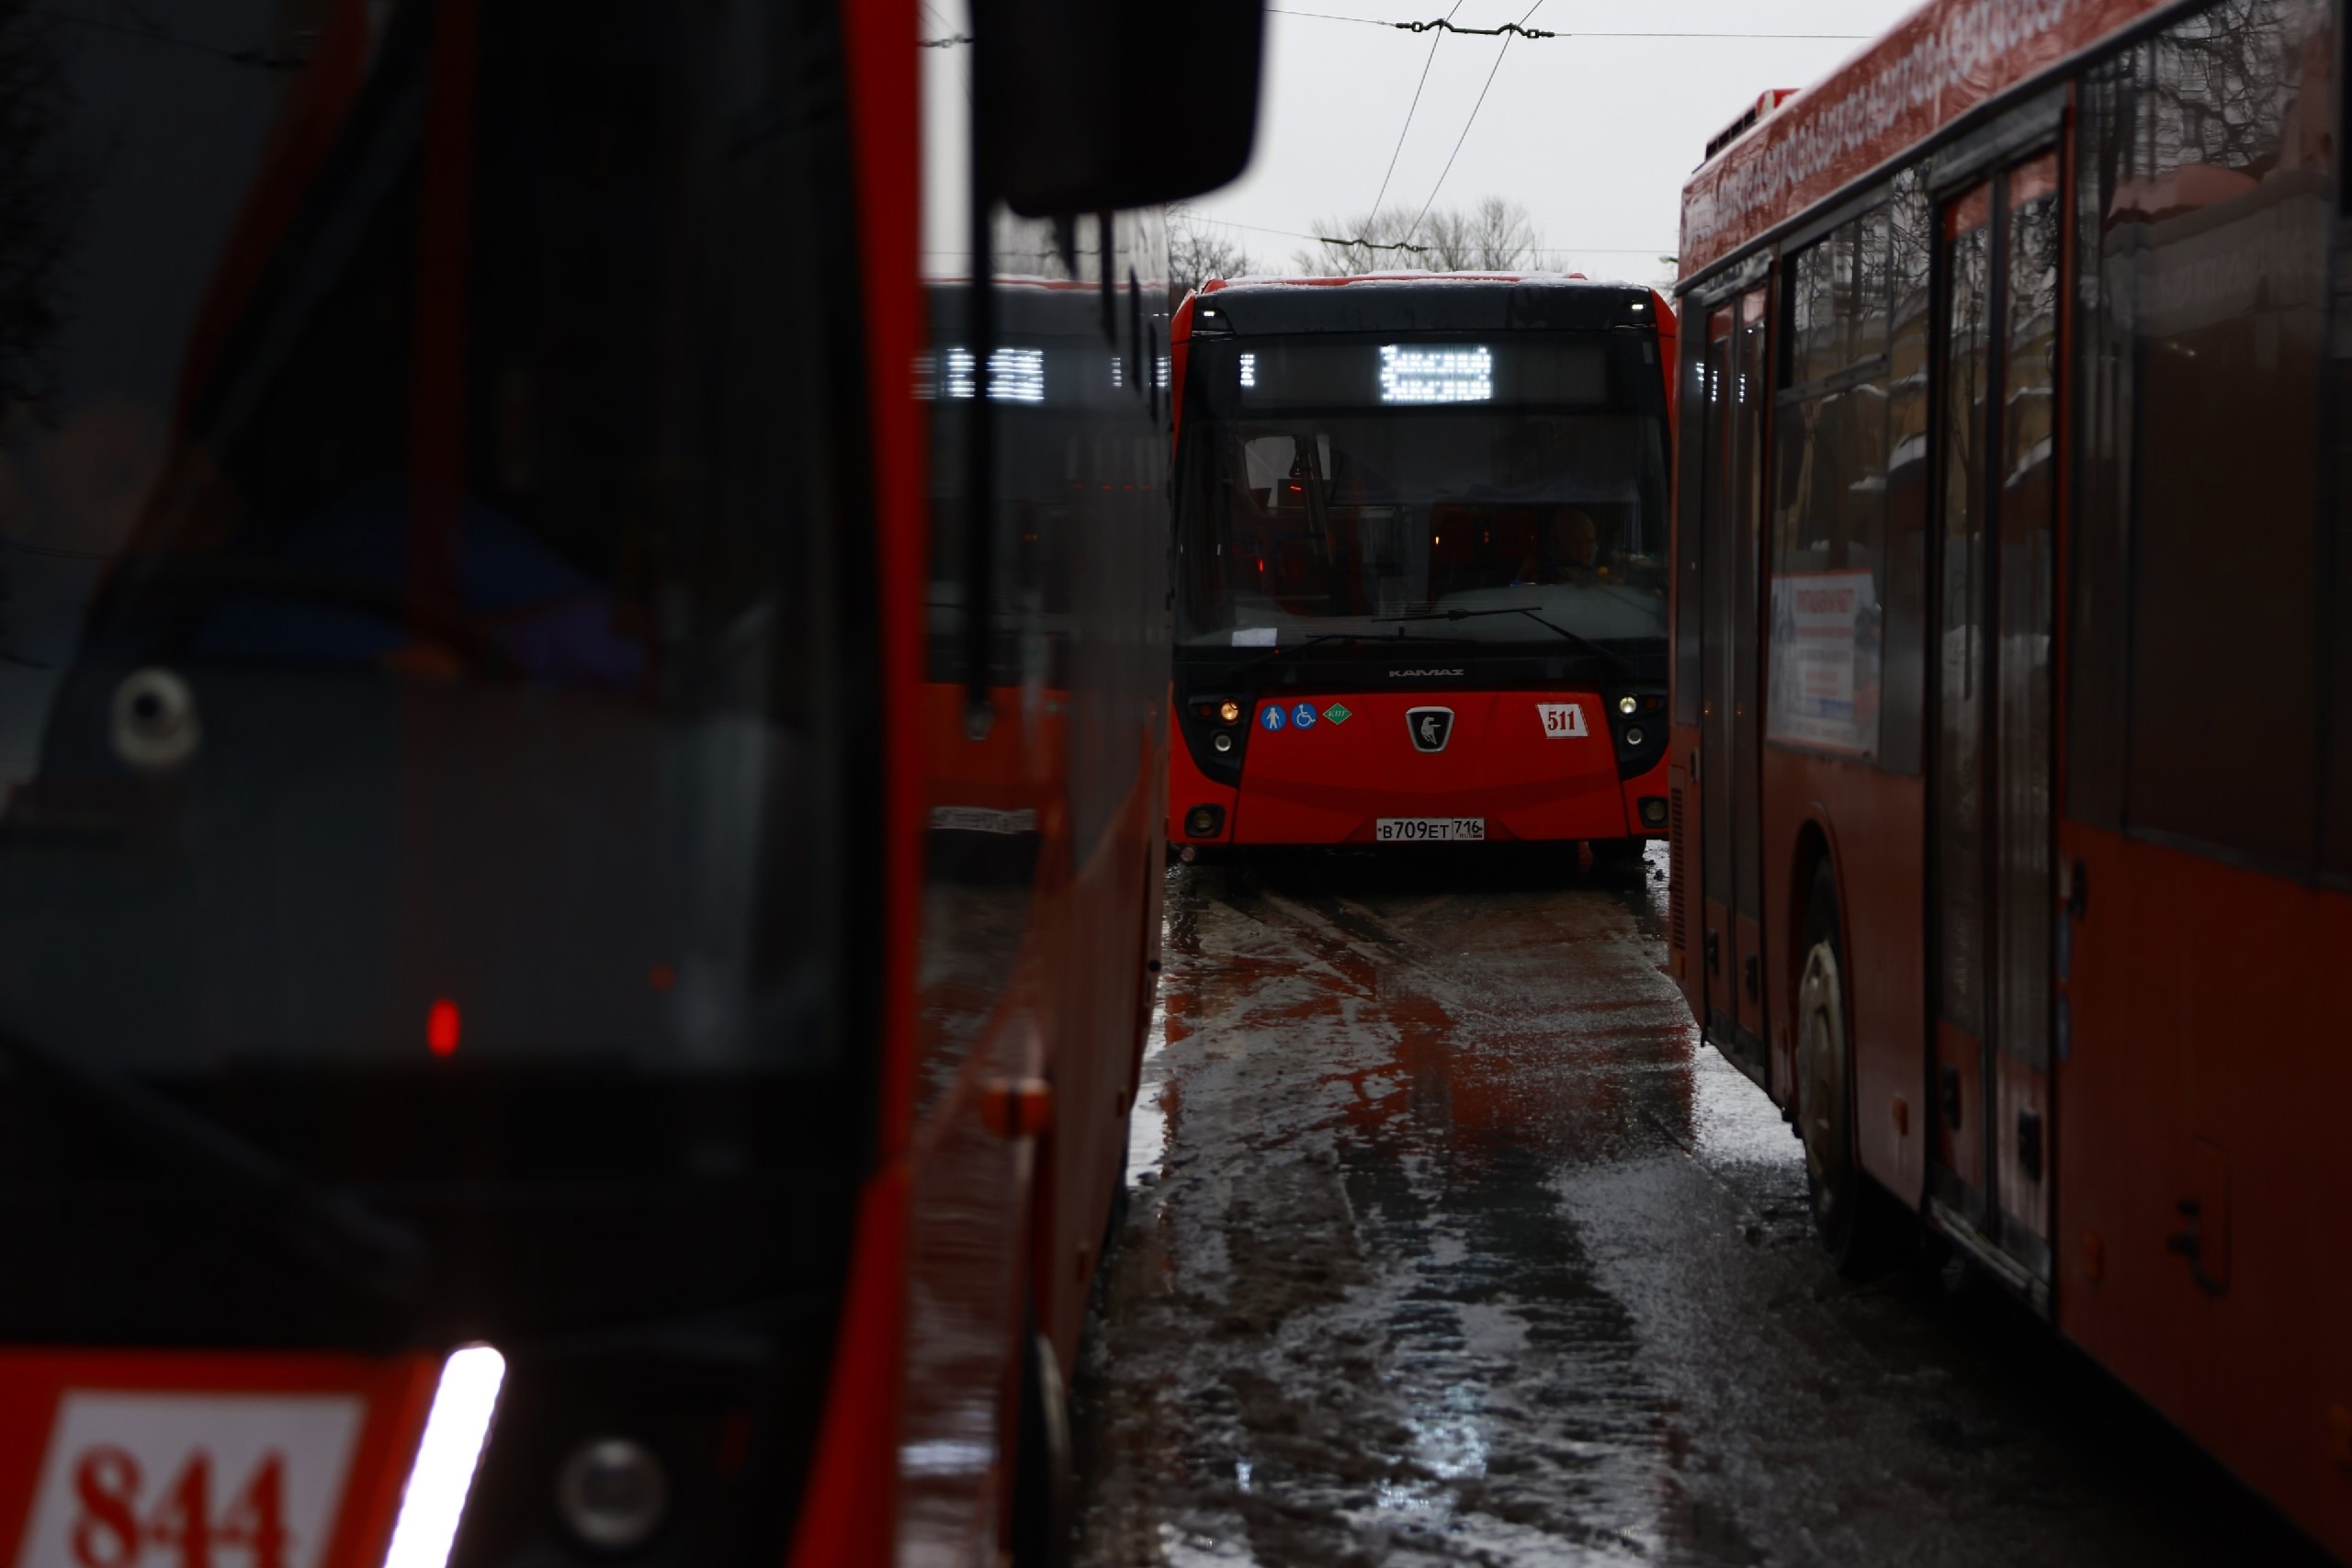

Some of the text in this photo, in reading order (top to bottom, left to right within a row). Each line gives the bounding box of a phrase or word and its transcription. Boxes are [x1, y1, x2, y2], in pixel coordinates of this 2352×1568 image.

[1389, 668, 1464, 677] KAMAZ
[1547, 710, 1576, 730] 511
[1453, 820, 1480, 833] 716
[74, 1445, 292, 1568] 844
